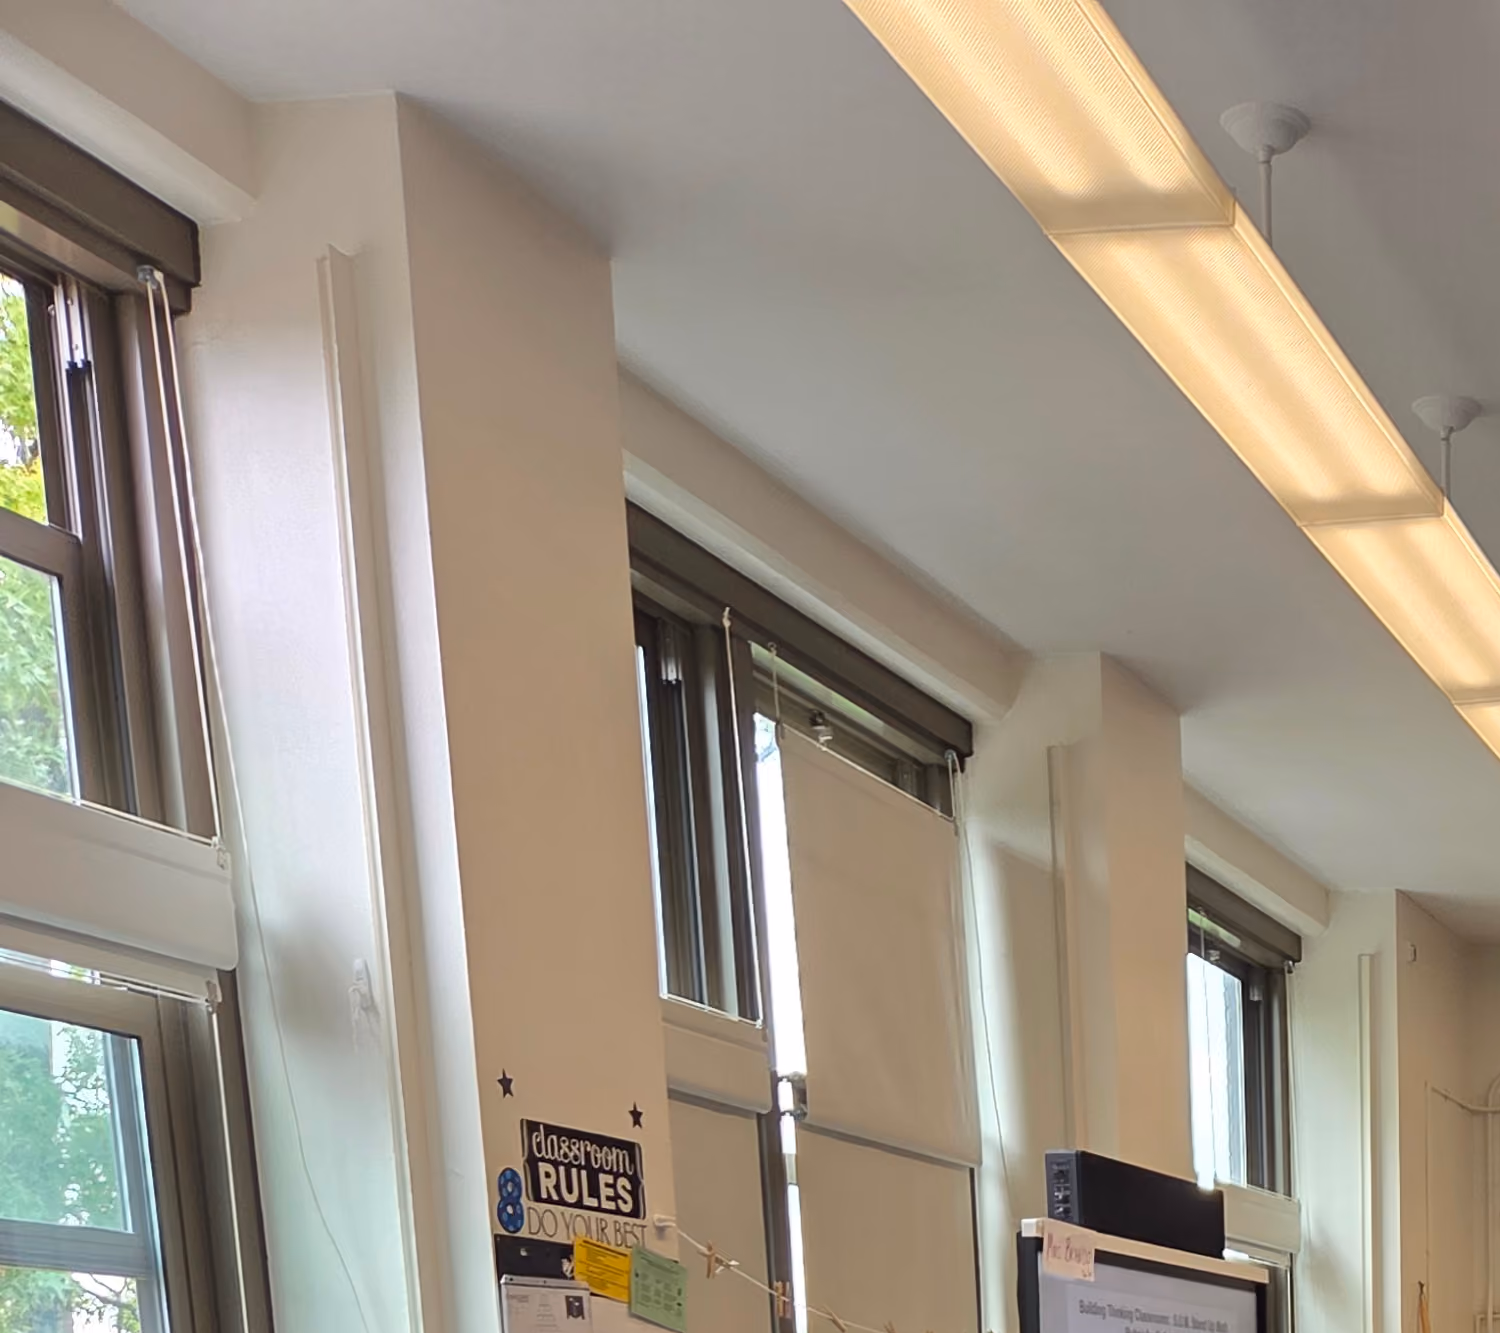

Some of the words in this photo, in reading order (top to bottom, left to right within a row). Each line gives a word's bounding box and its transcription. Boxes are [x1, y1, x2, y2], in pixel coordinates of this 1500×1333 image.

[532, 1124, 635, 1176] classroom
[496, 1167, 525, 1233] 8
[538, 1162, 634, 1213] RULES
[527, 1206, 558, 1237] DO
